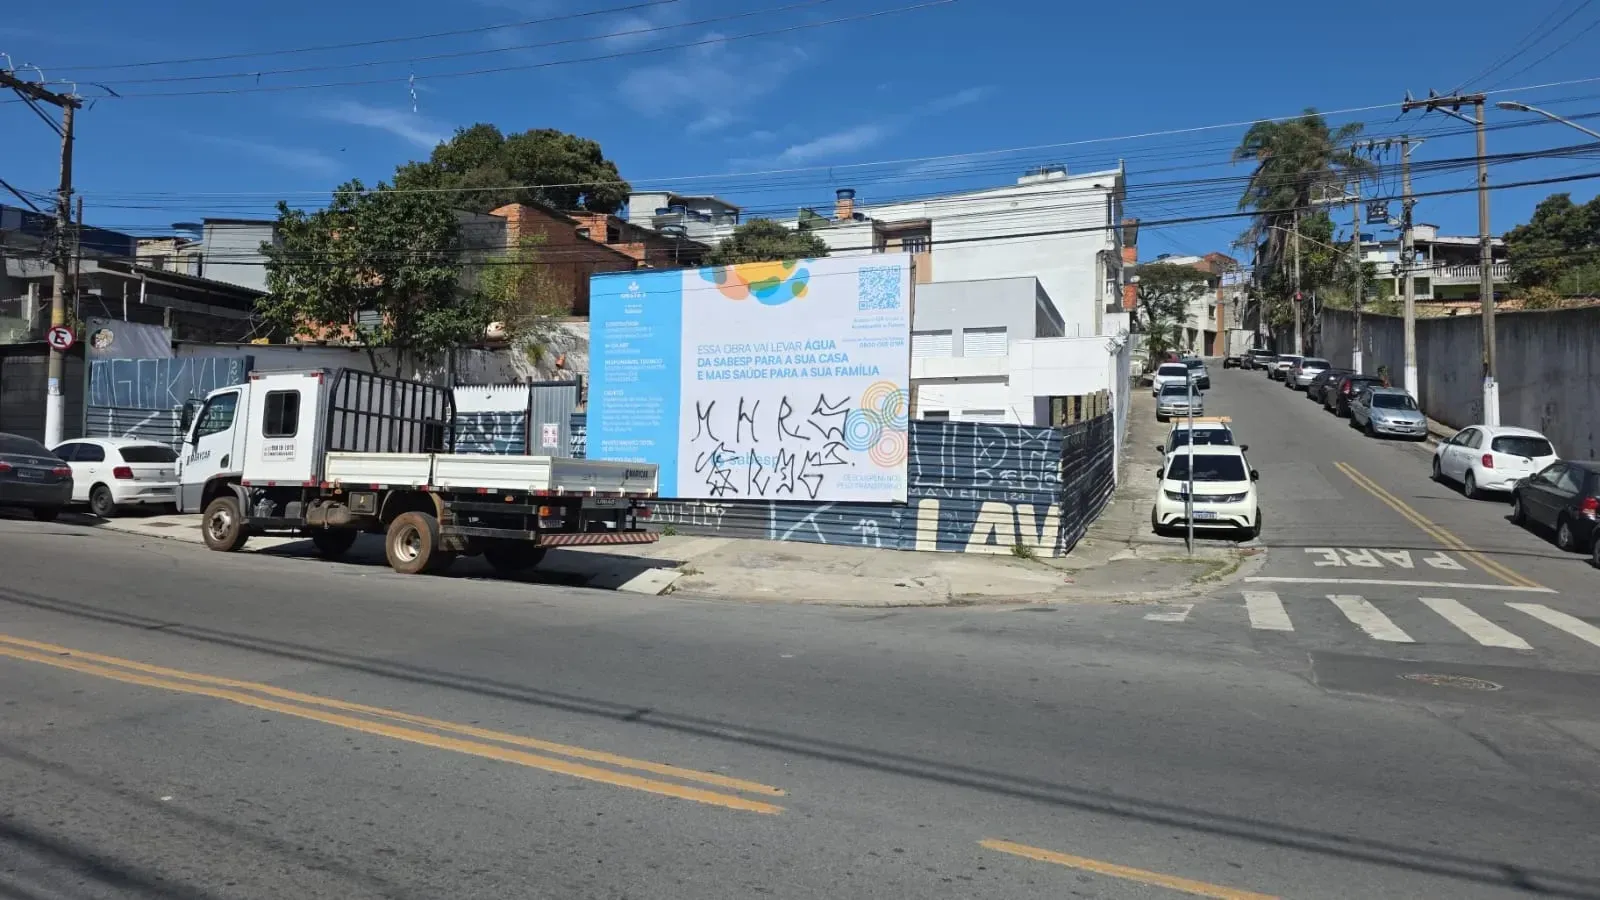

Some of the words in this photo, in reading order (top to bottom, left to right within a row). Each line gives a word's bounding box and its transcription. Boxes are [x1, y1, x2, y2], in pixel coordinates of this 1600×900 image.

[697, 345, 722, 355] ESSA
[724, 343, 751, 354] OBRA
[753, 342, 769, 353] VAI
[771, 341, 801, 352] LEVAR
[804, 339, 837, 350] ÁGUA
[697, 357, 712, 368] DA
[713, 355, 752, 367] SABESP
[754, 354, 783, 366] PARA
[784, 354, 793, 365] A
[794, 352, 817, 364] SUA
[818, 352, 849, 363] CASA
[697, 370, 704, 381] E
[705, 368, 732, 380] MAIS
[732, 366, 768, 379] SAÚDE
[769, 367, 799, 379] PARA
[800, 366, 808, 378] A
[810, 366, 833, 377] SUA
[834, 363, 880, 376] FAMÍLIA
[731, 453, 778, 468] sabesp
[1304, 547, 1468, 570] PARE
